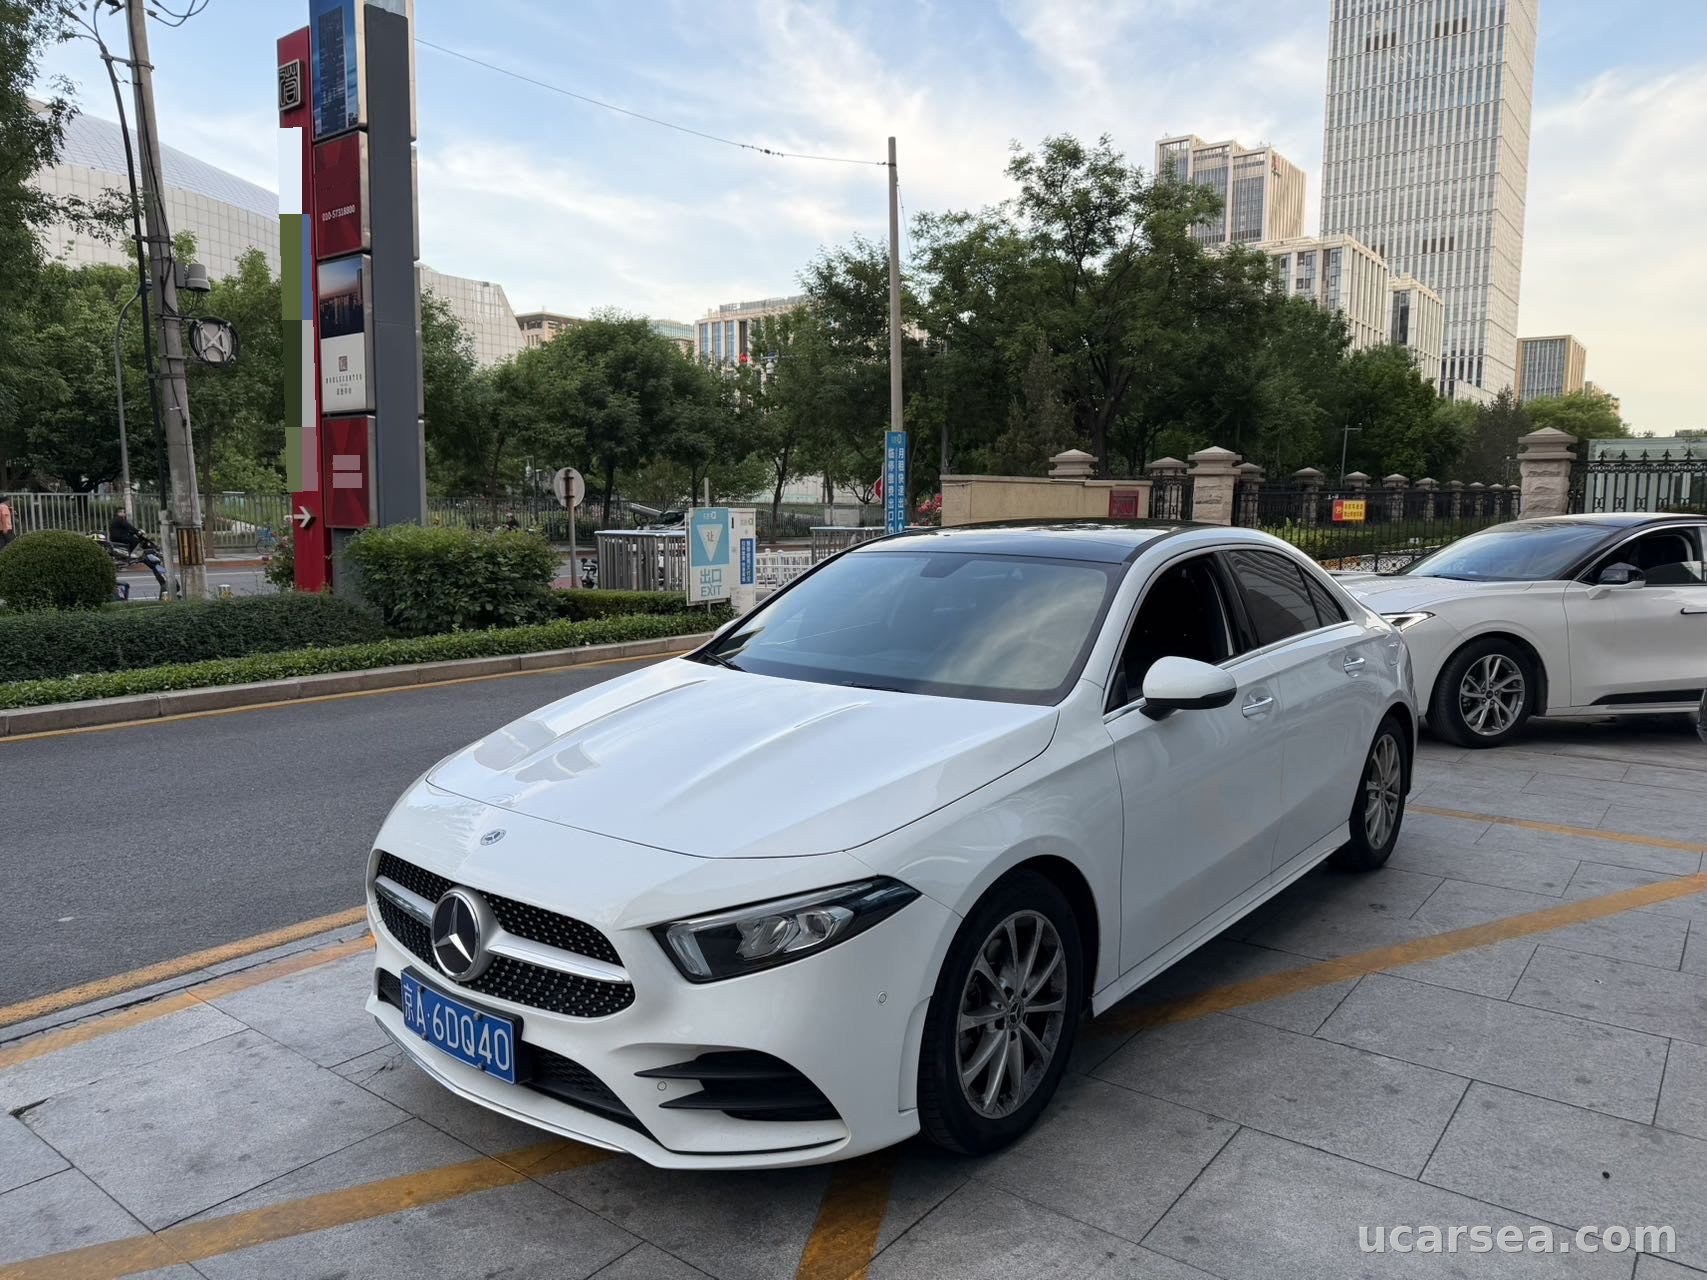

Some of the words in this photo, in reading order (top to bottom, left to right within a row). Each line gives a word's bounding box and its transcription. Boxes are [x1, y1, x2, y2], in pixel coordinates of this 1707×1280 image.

[706, 531, 714, 542] 让
[700, 568, 722, 584] 出口
[701, 584, 722, 597] EXIT
